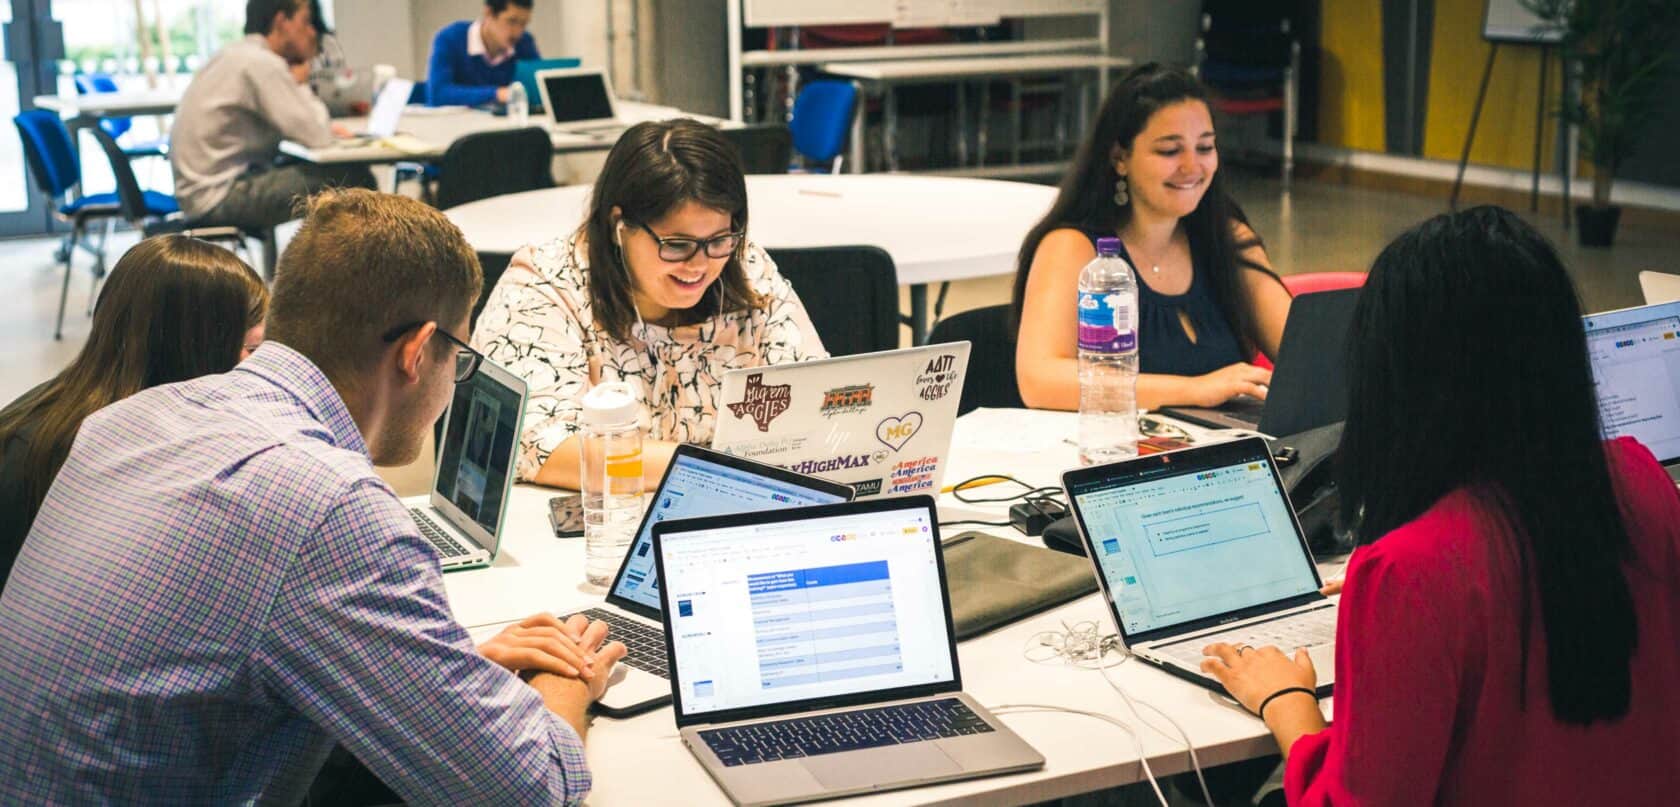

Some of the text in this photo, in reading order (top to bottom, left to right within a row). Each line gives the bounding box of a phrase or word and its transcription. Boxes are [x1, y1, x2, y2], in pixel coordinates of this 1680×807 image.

[919, 382, 951, 401] AGGIES
[735, 399, 788, 424] AGGIES
[885, 421, 913, 441] MG
